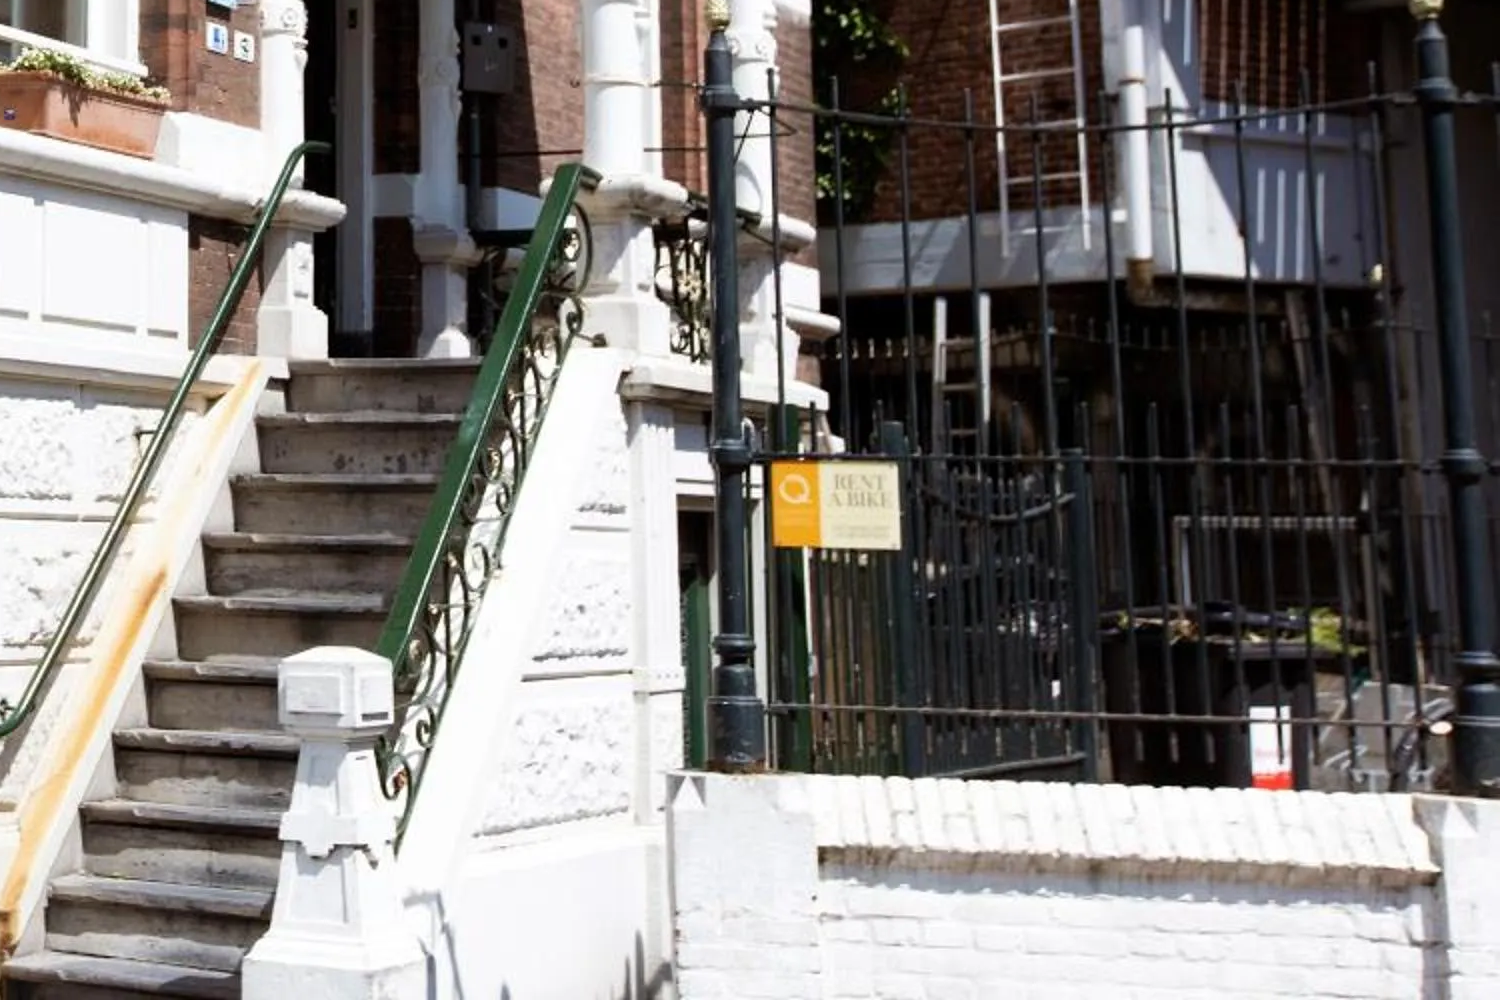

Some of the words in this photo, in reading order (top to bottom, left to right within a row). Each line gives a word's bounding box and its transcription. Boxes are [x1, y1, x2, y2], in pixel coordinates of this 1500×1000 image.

[778, 473, 813, 505] Q
[834, 473, 887, 491] RENT
[847, 491, 891, 508] BIKE
